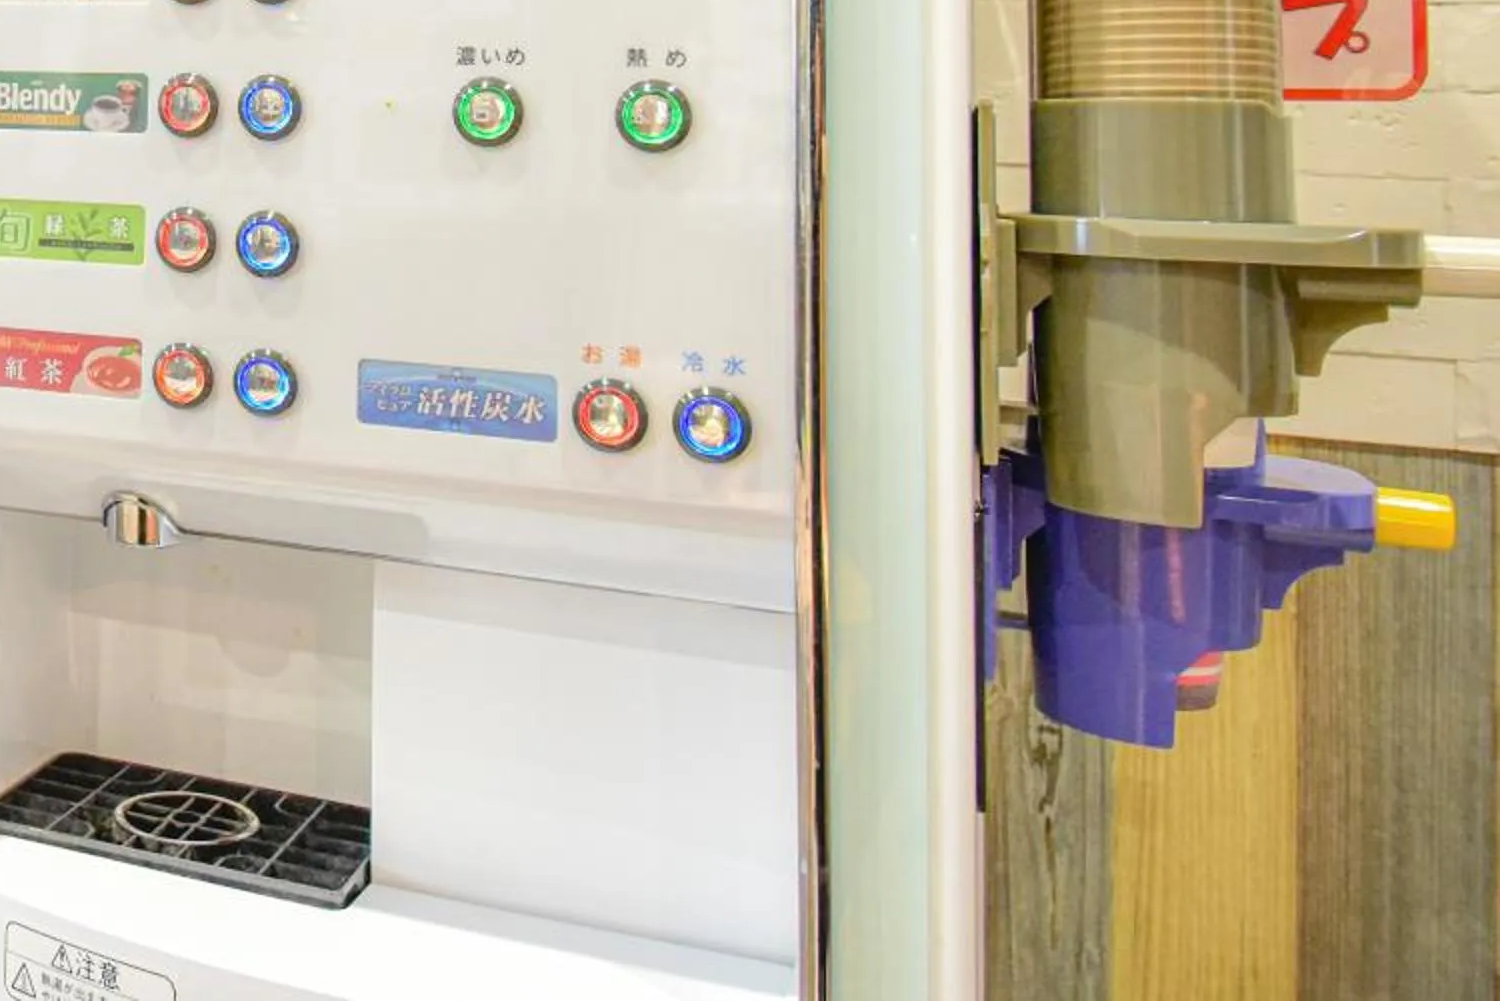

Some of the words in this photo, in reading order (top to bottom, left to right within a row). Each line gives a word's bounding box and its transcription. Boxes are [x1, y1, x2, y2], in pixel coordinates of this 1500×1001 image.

[4, 356, 65, 385] 紅茶
[682, 351, 746, 376] 冷水
[416, 386, 546, 425] 活性炭水
[75, 951, 121, 991] 注意
